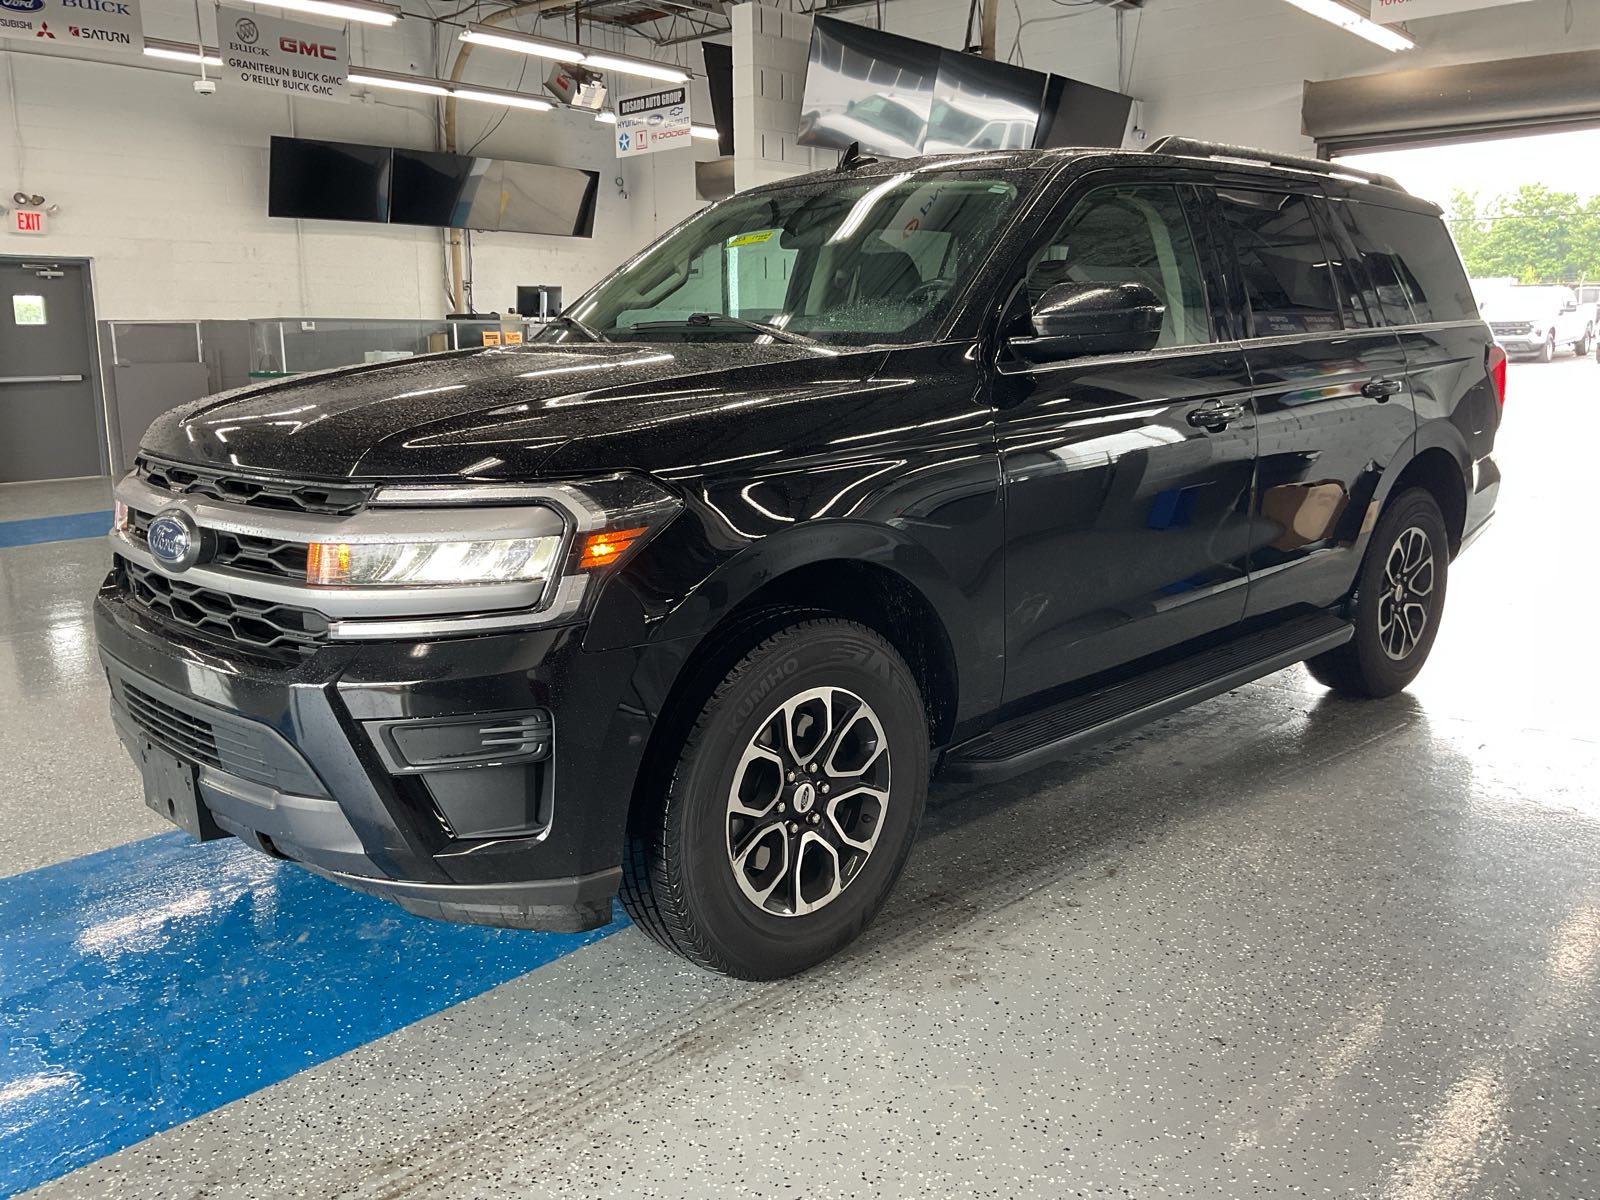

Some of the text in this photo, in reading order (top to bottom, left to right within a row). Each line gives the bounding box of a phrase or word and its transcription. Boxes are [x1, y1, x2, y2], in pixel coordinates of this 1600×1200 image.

[62, 0, 131, 16] BUICK
[0, 19, 33, 30] SUBISHI
[82, 28, 130, 44] SATURN
[229, 42, 270, 56] BUICK
[279, 37, 337, 60] GMC
[229, 58, 342, 86] GRANITERUN BUICK GMC
[241, 72, 333, 96] O'REILLY BUICK GMC
[645, 94, 661, 109] AUTO
[661, 90, 682, 106] GROUP
[658, 128, 690, 140] DODGE
[17, 212, 41, 231] EXIT
[152, 524, 178, 553] Ford
[728, 657, 799, 735] KUMHO
